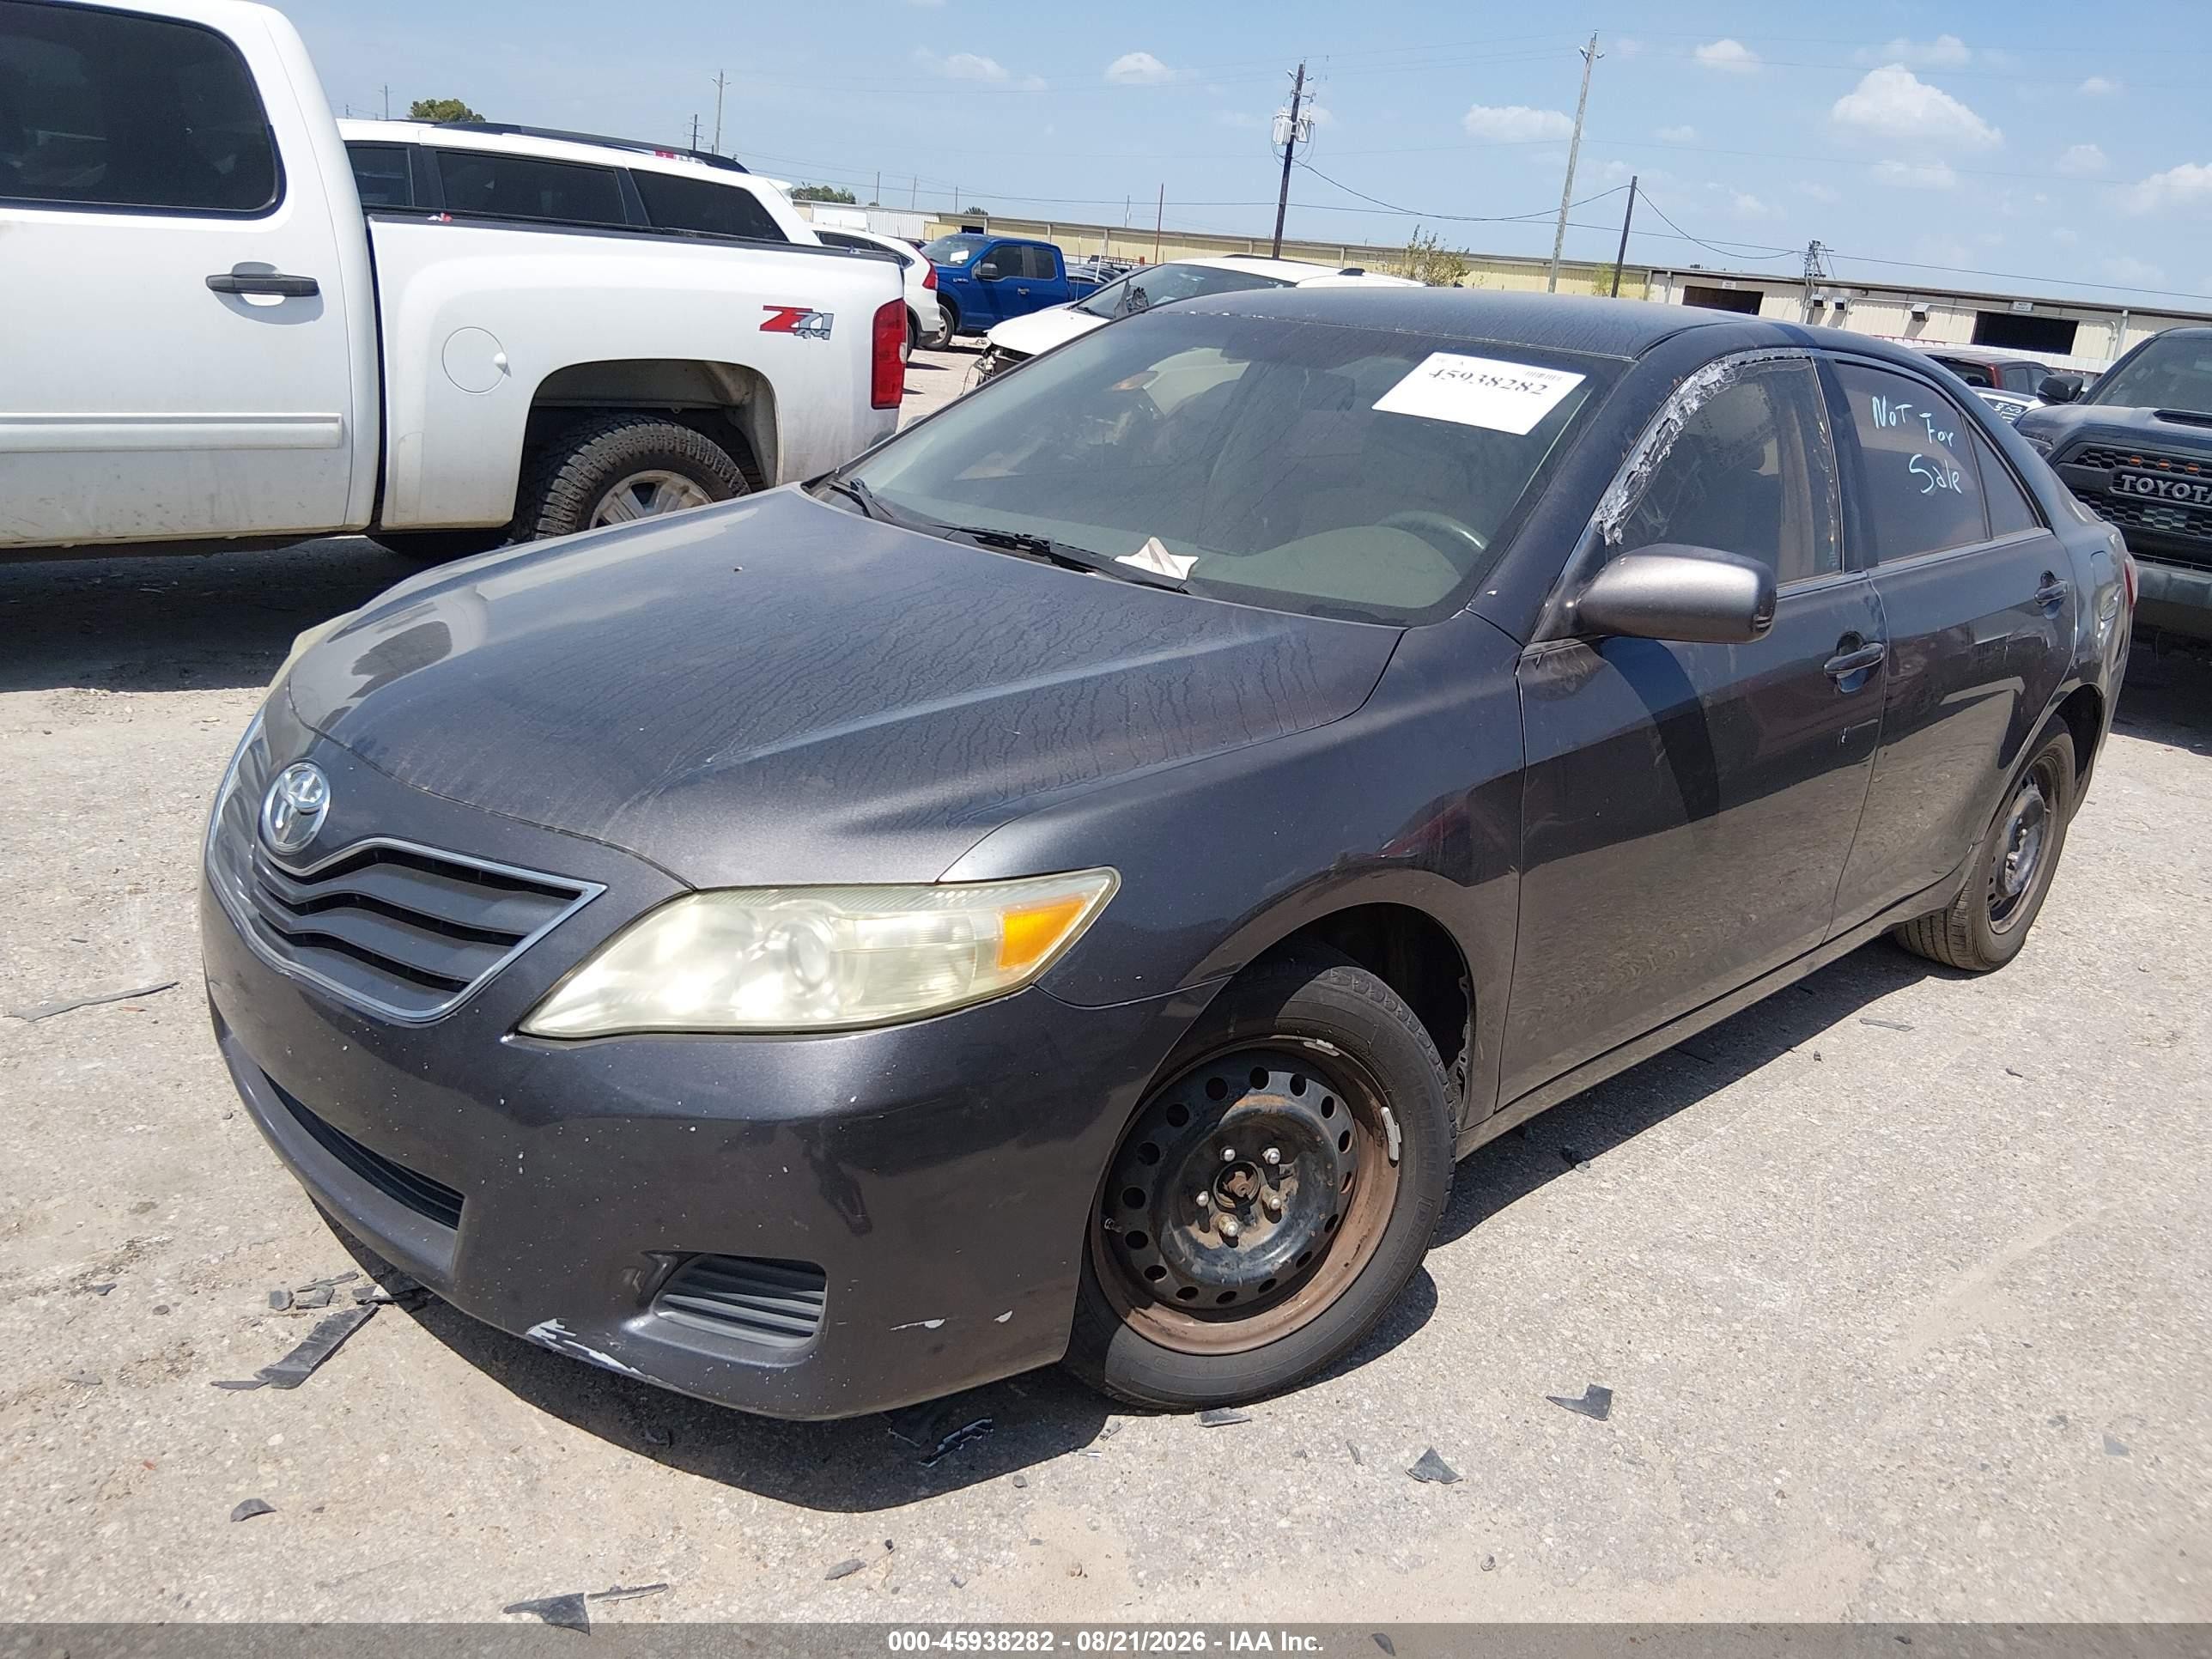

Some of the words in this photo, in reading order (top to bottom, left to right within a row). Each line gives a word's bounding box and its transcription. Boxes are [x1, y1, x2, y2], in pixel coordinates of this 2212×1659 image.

[760, 305, 834, 333] Z71
[1429, 368, 1548, 395] 45938282
[1908, 453, 1963, 495] Sale
